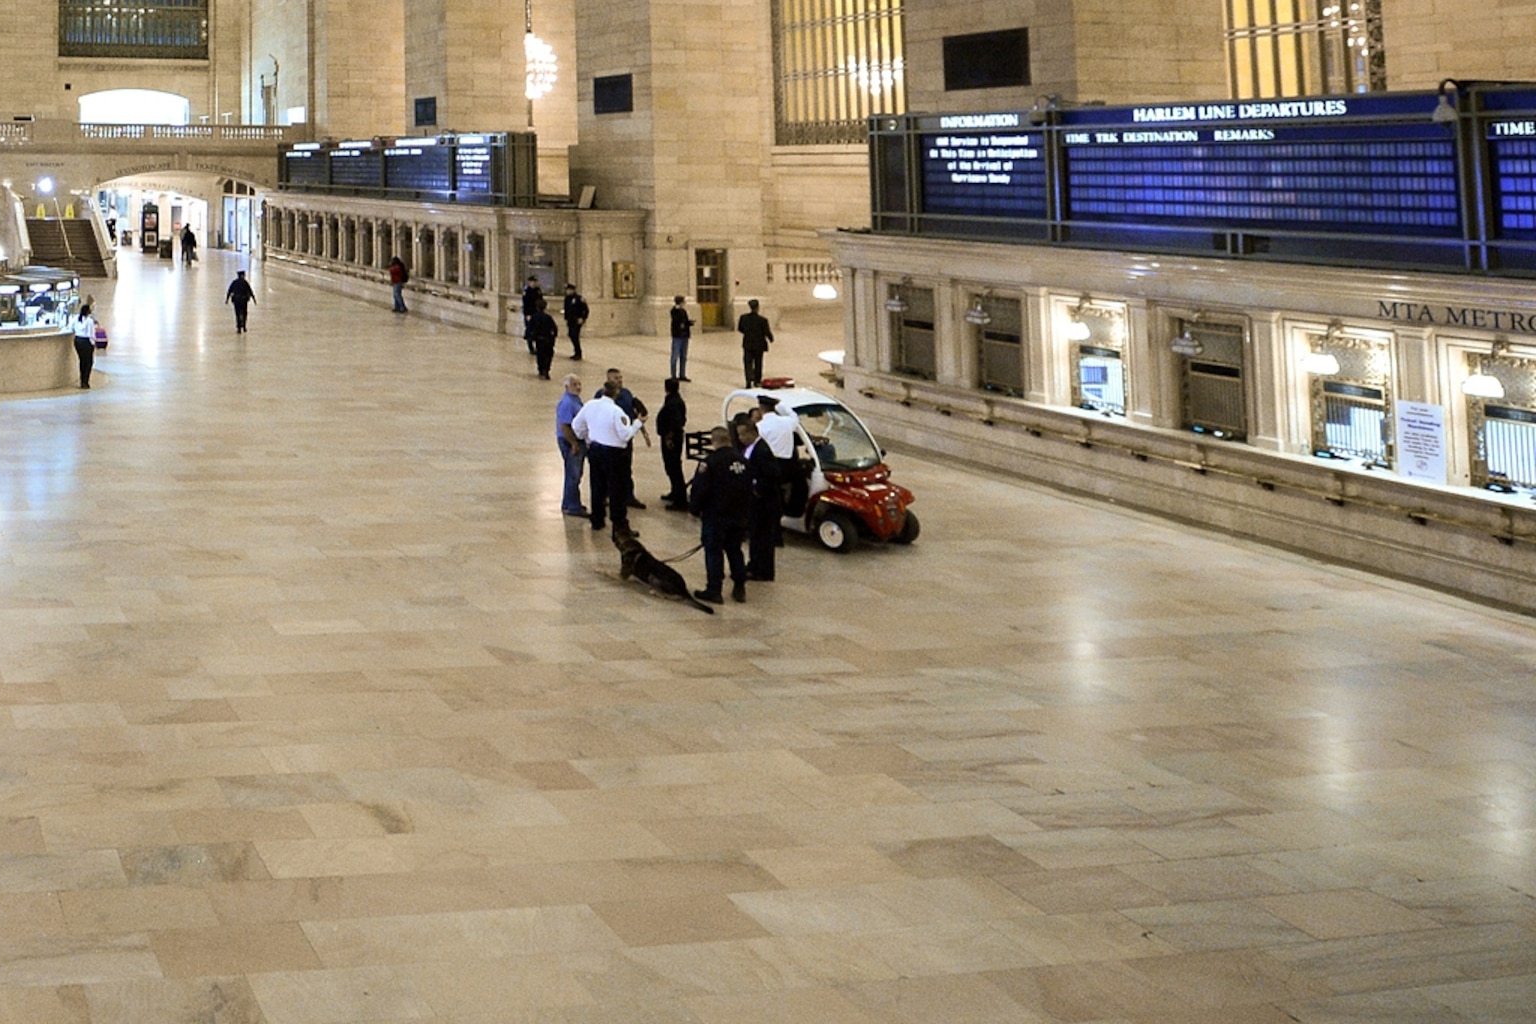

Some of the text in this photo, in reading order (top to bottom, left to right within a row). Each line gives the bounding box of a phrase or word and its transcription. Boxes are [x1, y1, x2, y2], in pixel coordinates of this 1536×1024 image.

[1132, 99, 1348, 123] HARLEM LINE DEPARTURES
[939, 113, 1019, 128] INFORMATION
[1122, 130, 1199, 144] DESTINATION
[1213, 129, 1276, 142] REMARKS
[1493, 122, 1536, 136] TIME
[1378, 300, 1434, 323] MTA
